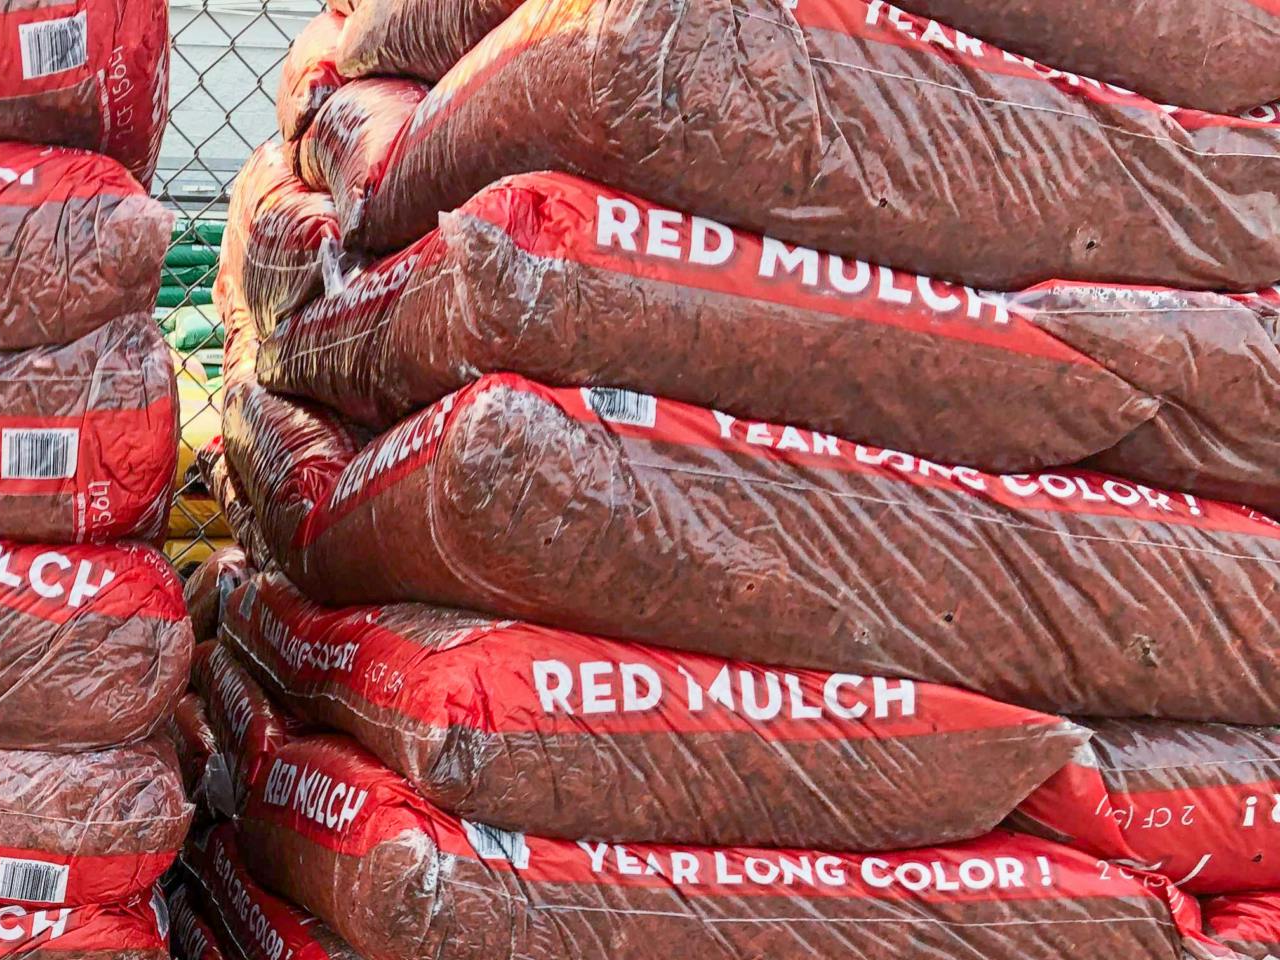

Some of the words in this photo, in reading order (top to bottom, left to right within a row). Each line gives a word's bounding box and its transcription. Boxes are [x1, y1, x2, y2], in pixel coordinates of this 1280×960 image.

[597, 197, 736, 267] RED
[758, 236, 1011, 325] MULCH
[712, 408, 841, 456] YEAR
[532, 660, 662, 716] RED
[677, 664, 916, 720] MULCH
[293, 762, 369, 833] MULCH
[1142, 806, 1172, 829] CF
[1180, 805, 1195, 826] 2
[577, 840, 701, 885] YEAR
[714, 851, 846, 887] LONG
